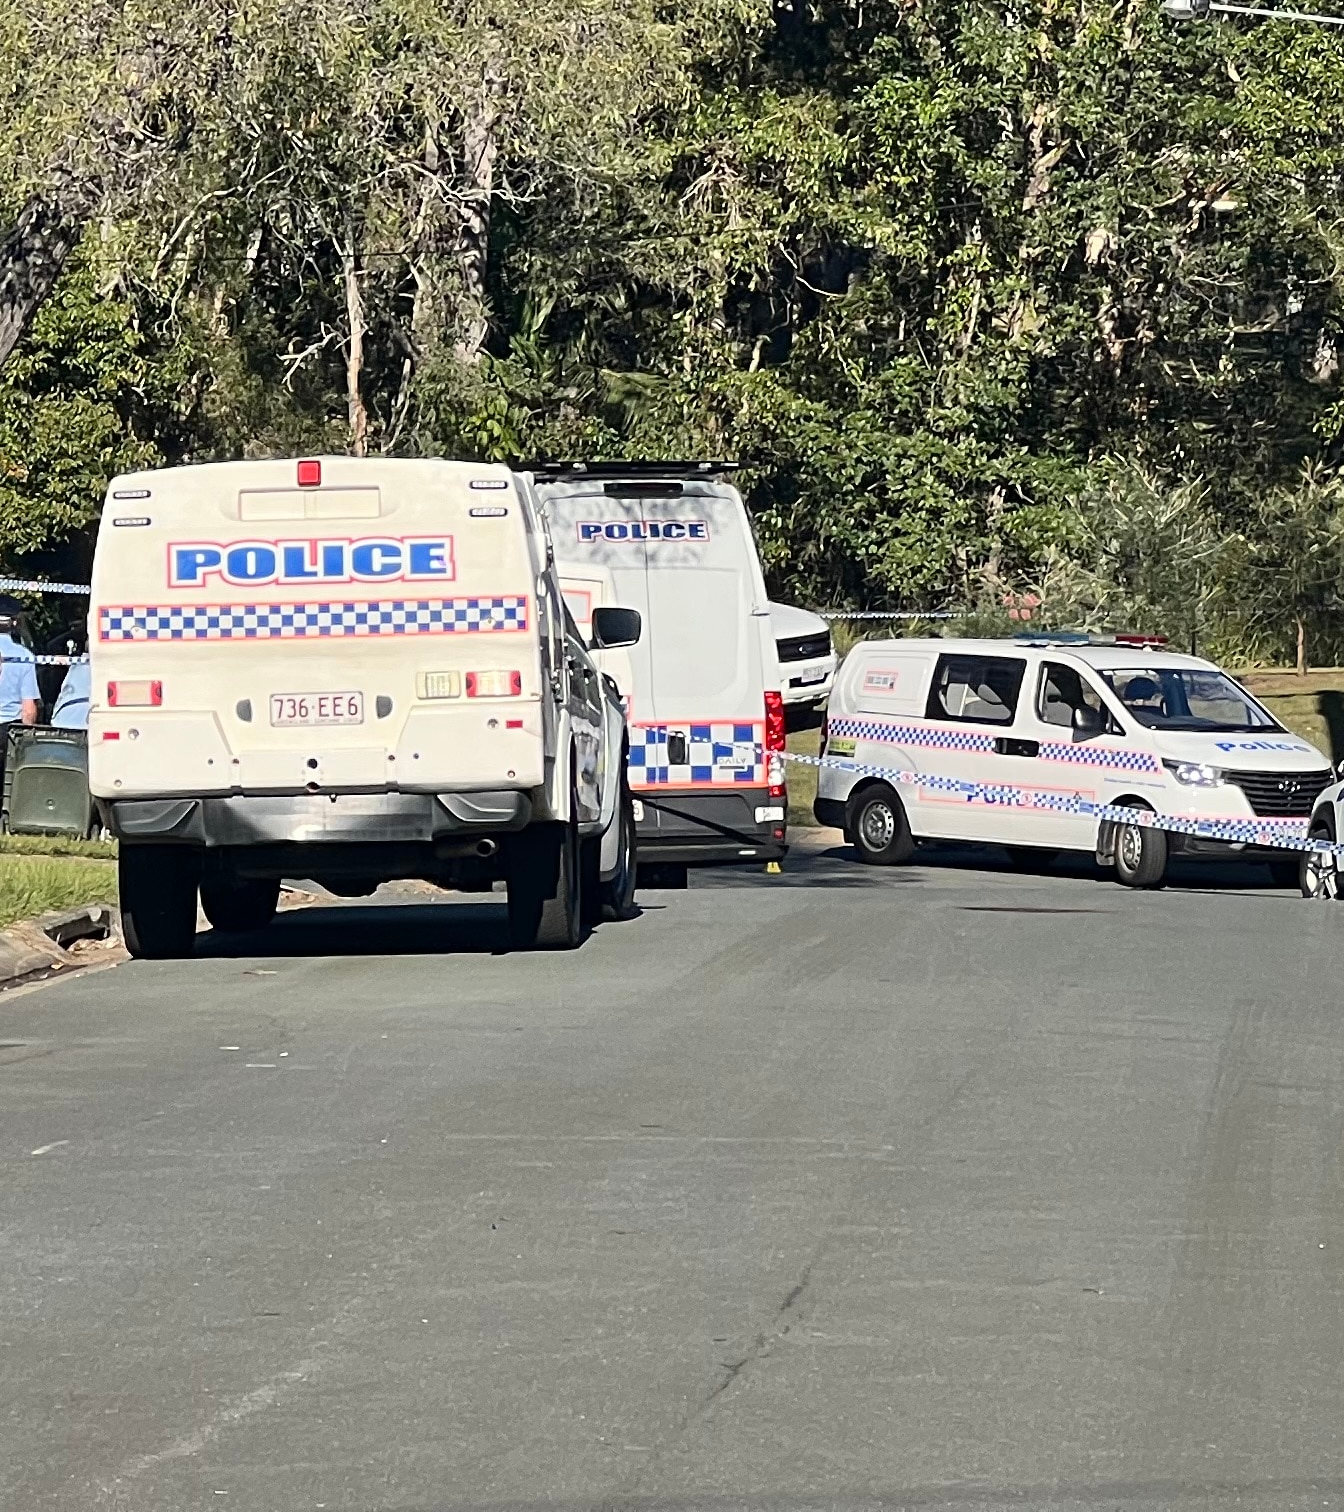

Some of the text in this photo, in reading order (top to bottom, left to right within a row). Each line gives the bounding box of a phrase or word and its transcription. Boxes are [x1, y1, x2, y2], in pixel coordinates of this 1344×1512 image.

[578, 522, 707, 540] POLICE
[173, 540, 450, 583] POLICE
[1214, 741, 1312, 753] Police
